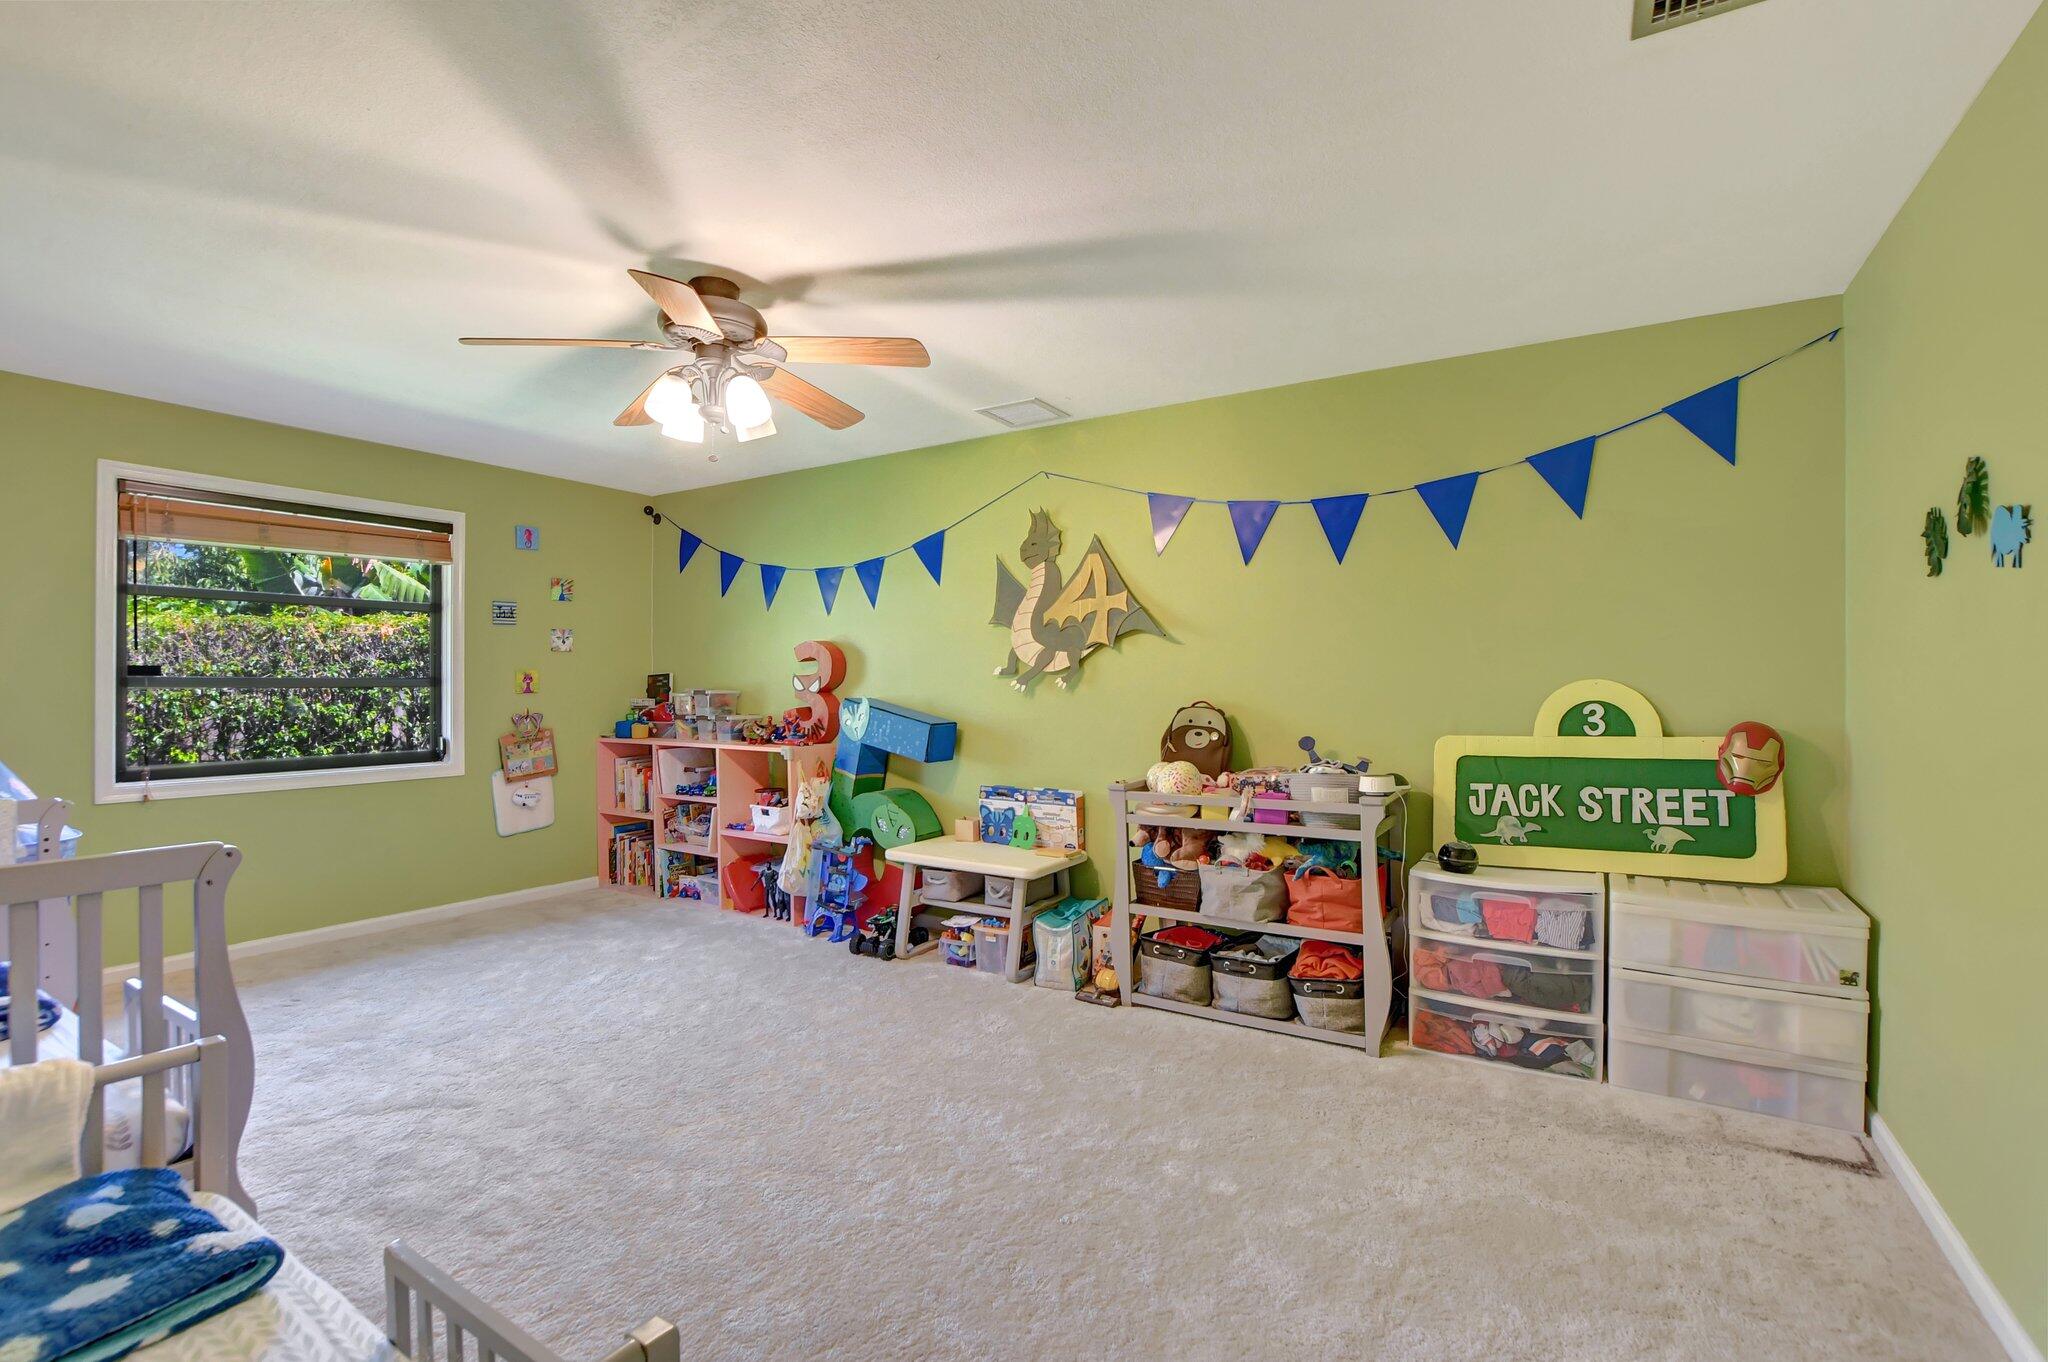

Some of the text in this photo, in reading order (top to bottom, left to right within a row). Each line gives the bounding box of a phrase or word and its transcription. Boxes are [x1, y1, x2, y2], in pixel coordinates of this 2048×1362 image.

[1043, 552, 1127, 646] 4
[783, 640, 848, 744] 3
[1582, 703, 1606, 736] 3
[1468, 783, 1736, 827] JACK STREET
